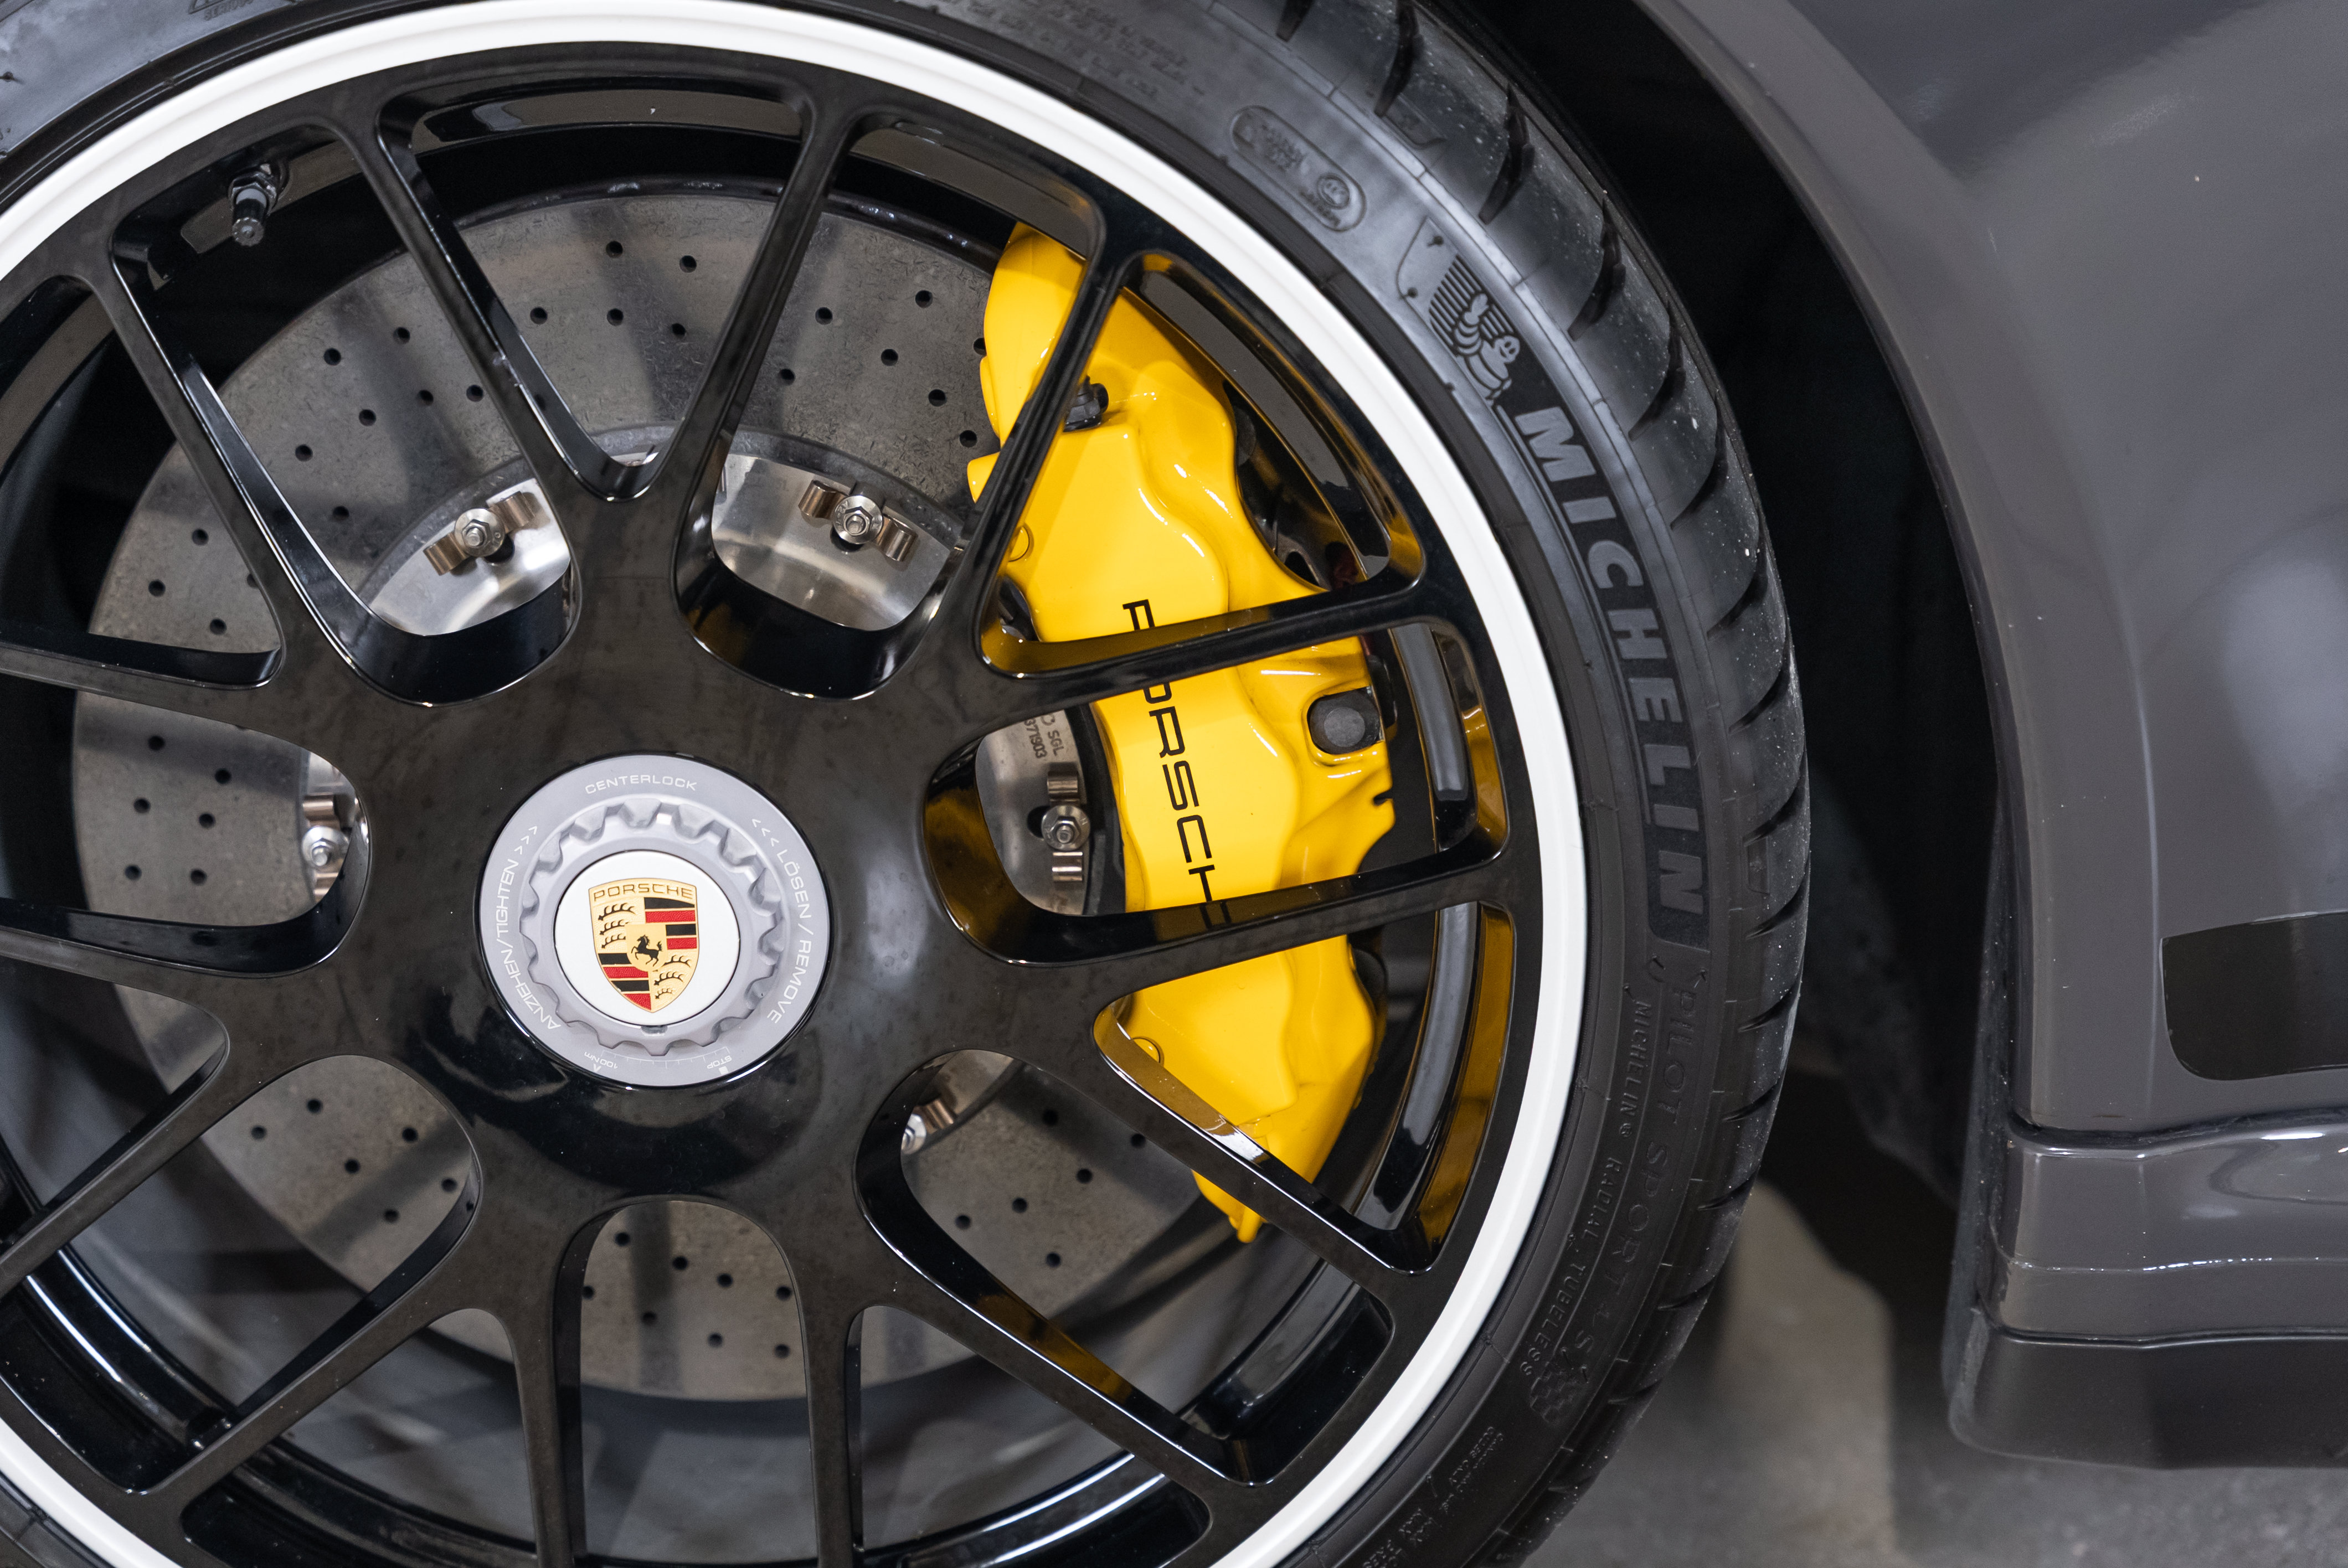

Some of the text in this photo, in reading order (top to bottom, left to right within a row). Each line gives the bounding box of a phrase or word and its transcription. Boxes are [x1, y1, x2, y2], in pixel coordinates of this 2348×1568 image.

[1515, 406, 1704, 915] MICHELIN
[1048, 729, 1064, 756] SGL
[585, 775, 697, 795] CENTERLOCK
[594, 883, 693, 902] PORSCHE
[776, 848, 812, 919] LÖSEN
[767, 940, 812, 1024] REMOVE
[707, 1055, 733, 1070] STOP
[1659, 987, 1697, 1125] PILOT
[1520, 1262, 1586, 1376] TUBELESS
